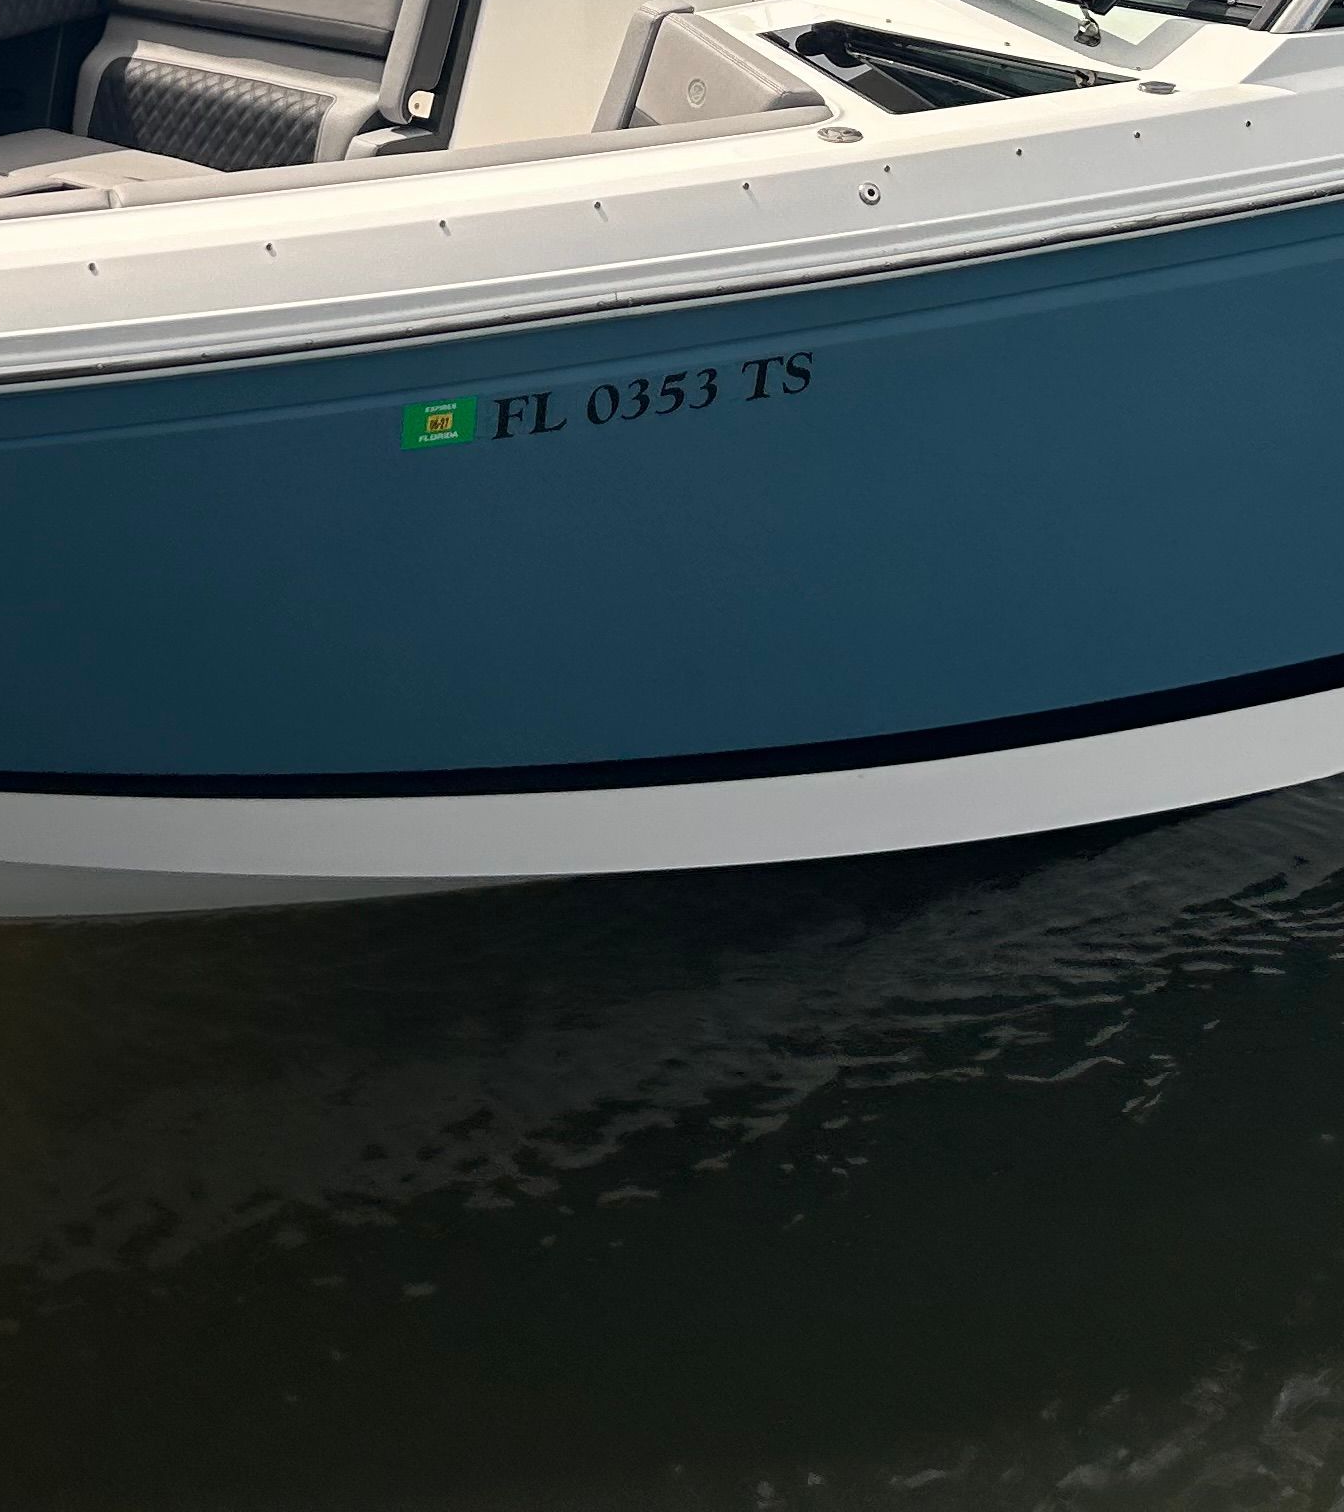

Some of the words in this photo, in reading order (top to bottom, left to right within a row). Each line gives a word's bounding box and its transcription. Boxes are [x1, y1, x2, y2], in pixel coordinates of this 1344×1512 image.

[492, 392, 567, 440] FL
[586, 367, 718, 426] 0353
[741, 350, 814, 402] TS
